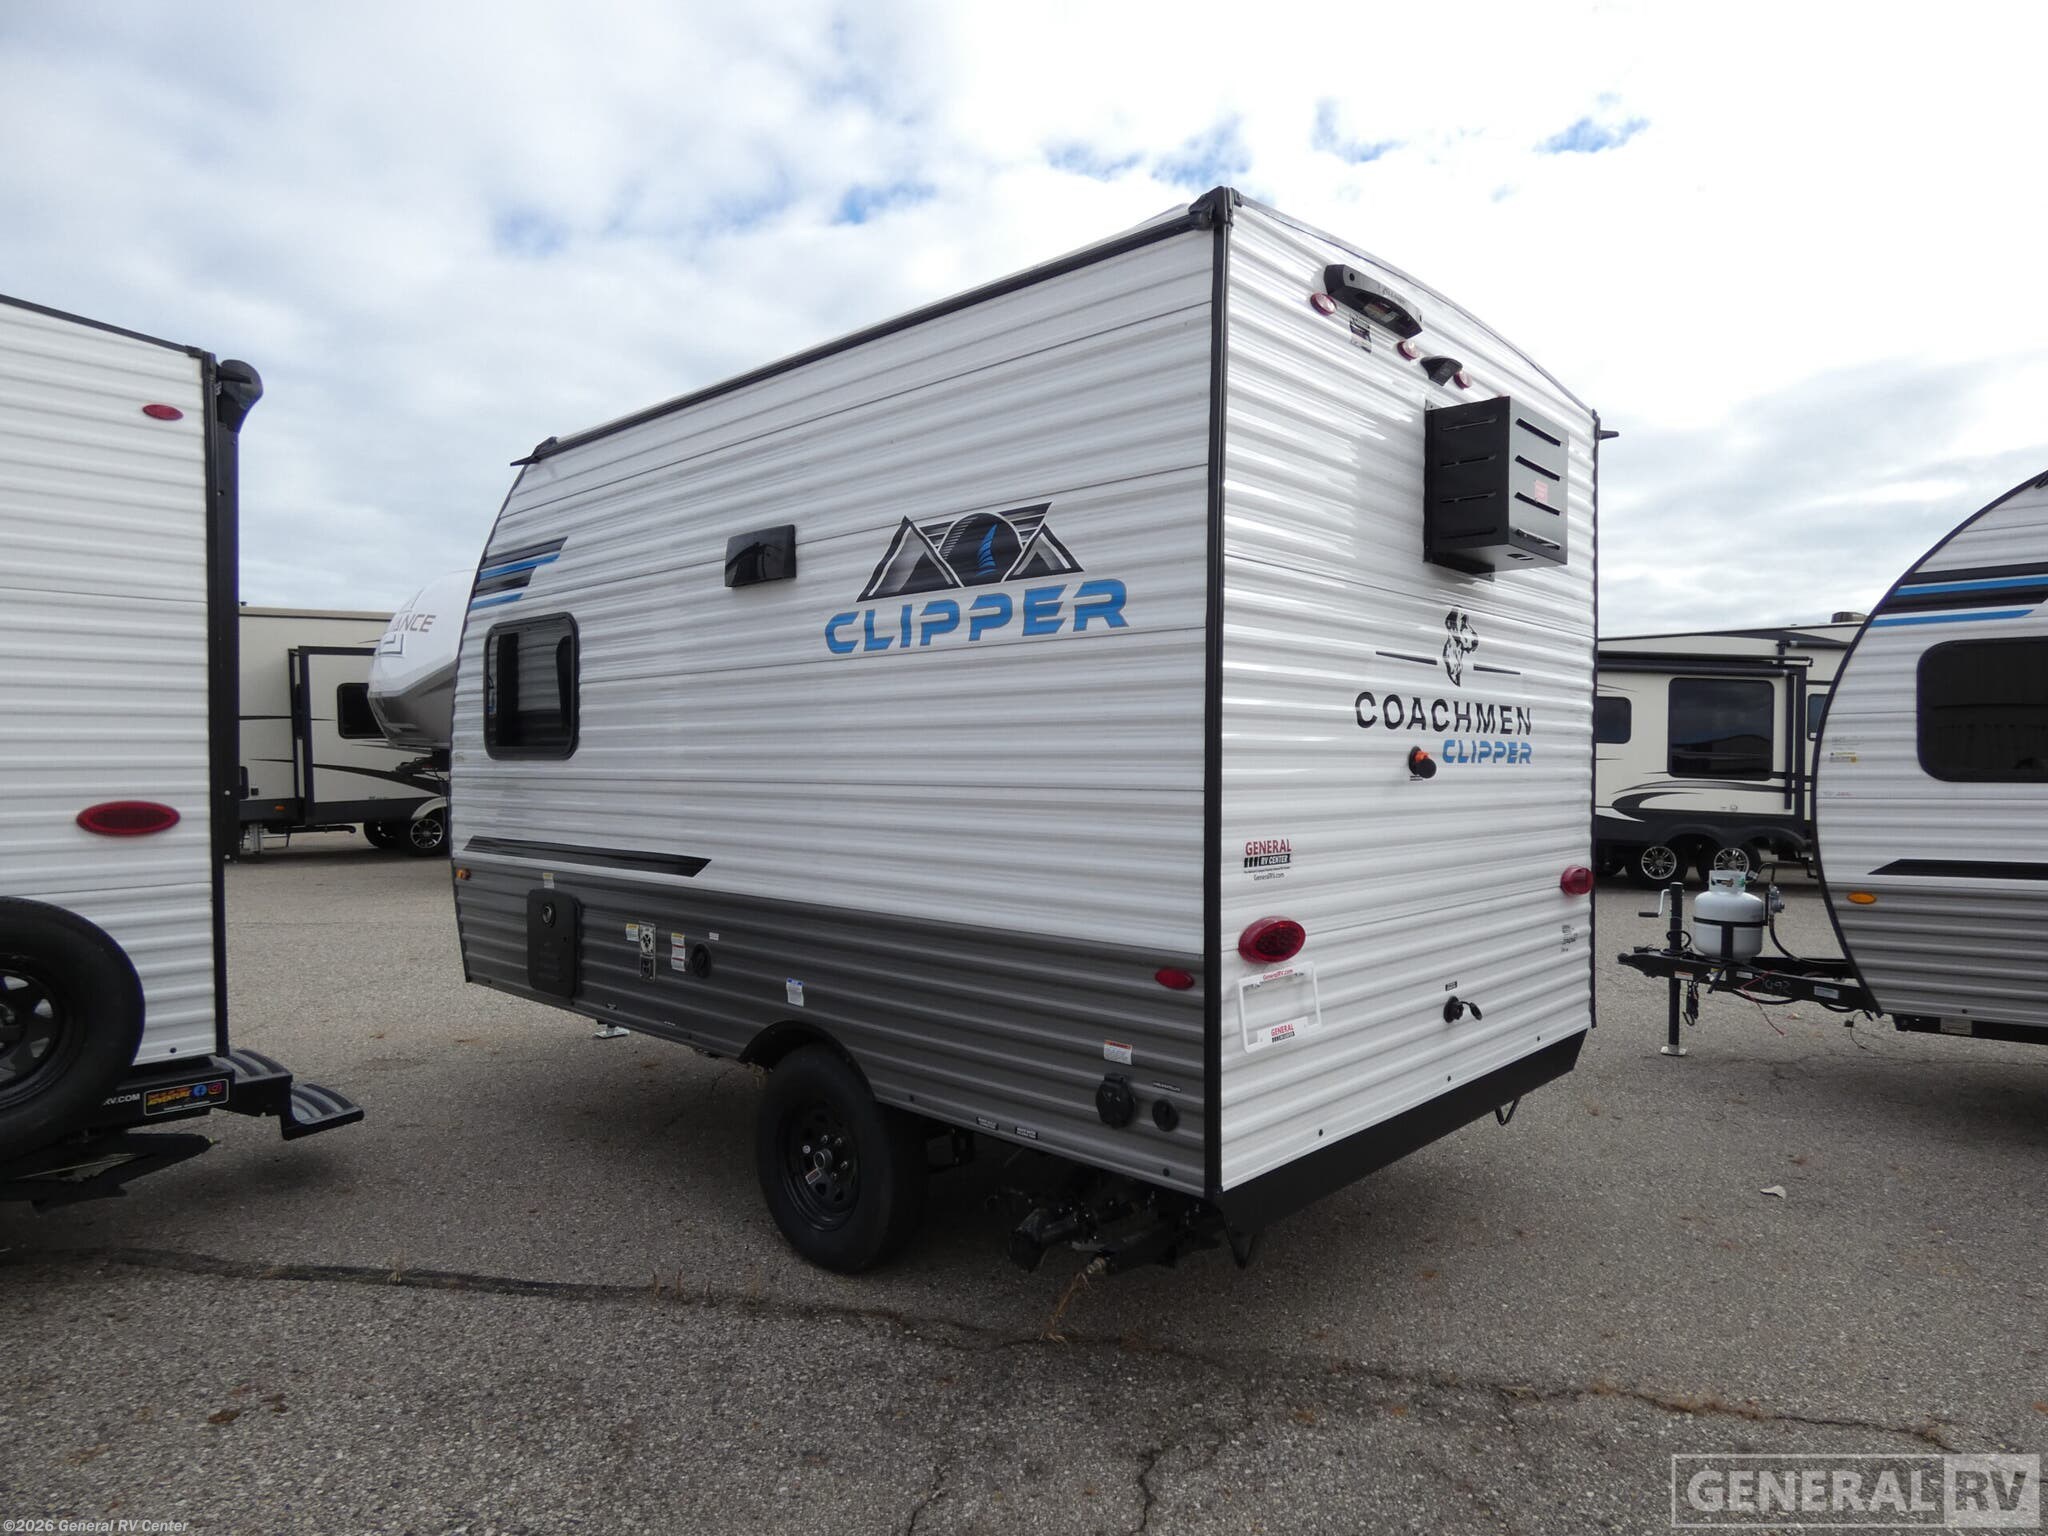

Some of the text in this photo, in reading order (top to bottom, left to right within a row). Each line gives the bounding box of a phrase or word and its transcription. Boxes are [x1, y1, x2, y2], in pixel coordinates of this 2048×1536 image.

[825, 579, 1129, 655] CLIPPER
[1355, 691, 1532, 735] COACHMEN
[1442, 739, 1532, 764] CLIPPER
[1245, 839, 1292, 856] GENERAL
